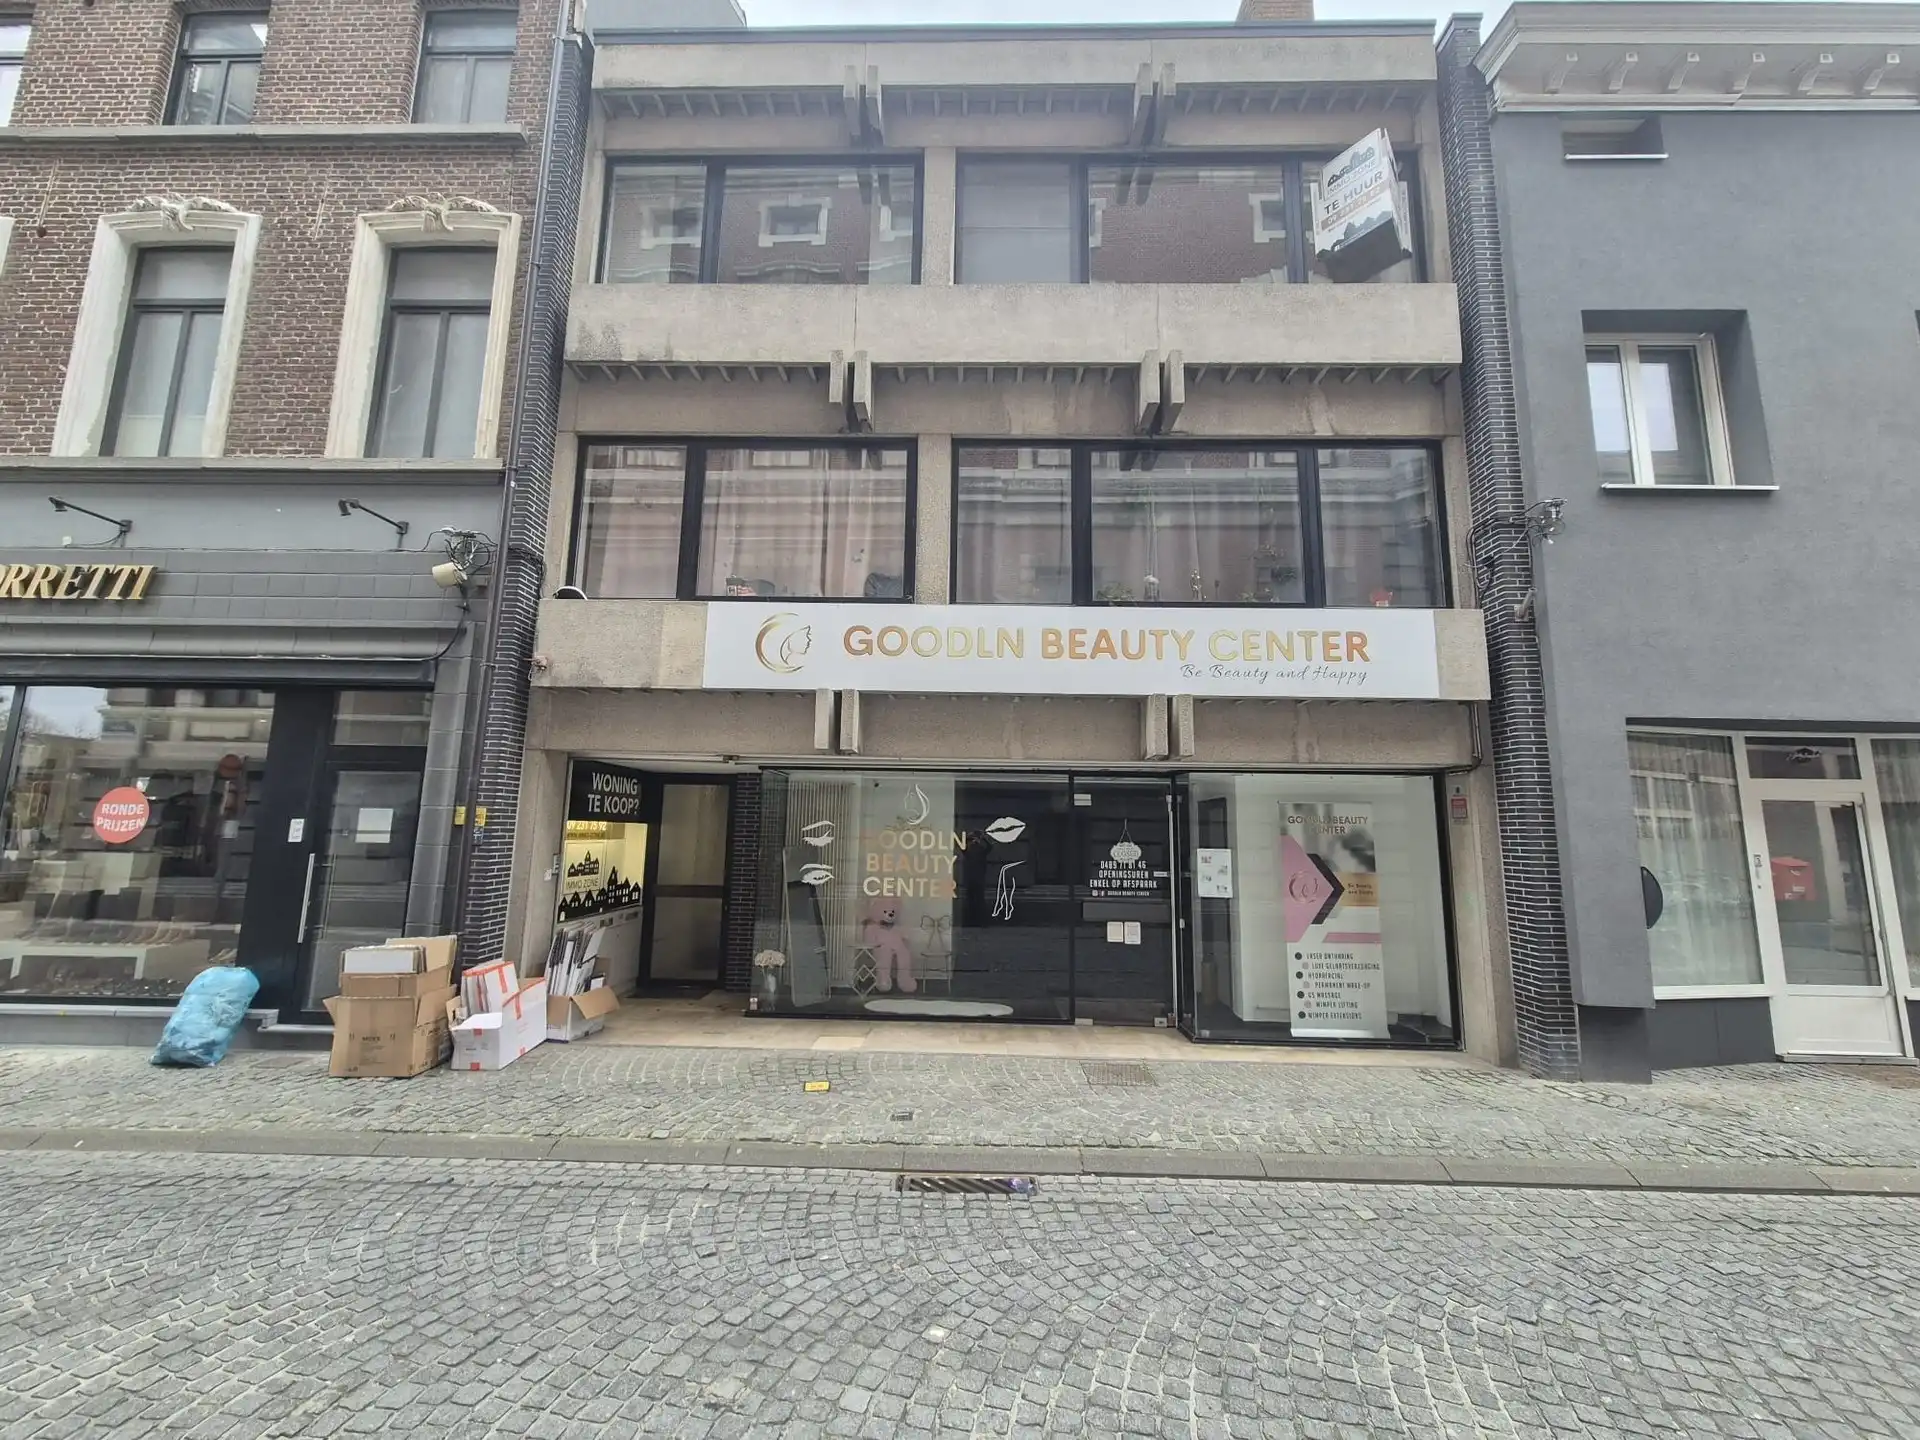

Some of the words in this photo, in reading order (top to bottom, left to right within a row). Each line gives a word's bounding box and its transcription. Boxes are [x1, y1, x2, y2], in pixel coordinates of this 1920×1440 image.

[1324, 200, 1340, 215] TE
[1343, 171, 1383, 203] HUUR
[843, 625, 1024, 659] GOODLN
[1041, 628, 1195, 661] BEAUTY
[1208, 630, 1371, 663] CENTER
[1180, 664, 1202, 679] Be
[1209, 664, 1269, 685] Beauty
[1276, 665, 1310, 679] and
[1311, 665, 1369, 685] Happy
[592, 771, 639, 794] WONING
[101, 803, 145, 816] RONDE
[588, 794, 601, 813] TE
[603, 795, 640, 815] KOOP?
[96, 816, 146, 832] PRIJZEN
[1333, 816, 1368, 824] BEAUTY
[860, 830, 968, 851] OODLN
[866, 852, 958, 875] BEAUTY
[565, 878, 583, 890] IMMO
[583, 877, 599, 887] ZONE
[1090, 879, 1110, 888] ENKEL
[1111, 879, 1121, 888] OP
[1099, 870, 1149, 879] OPENINGSUREN
